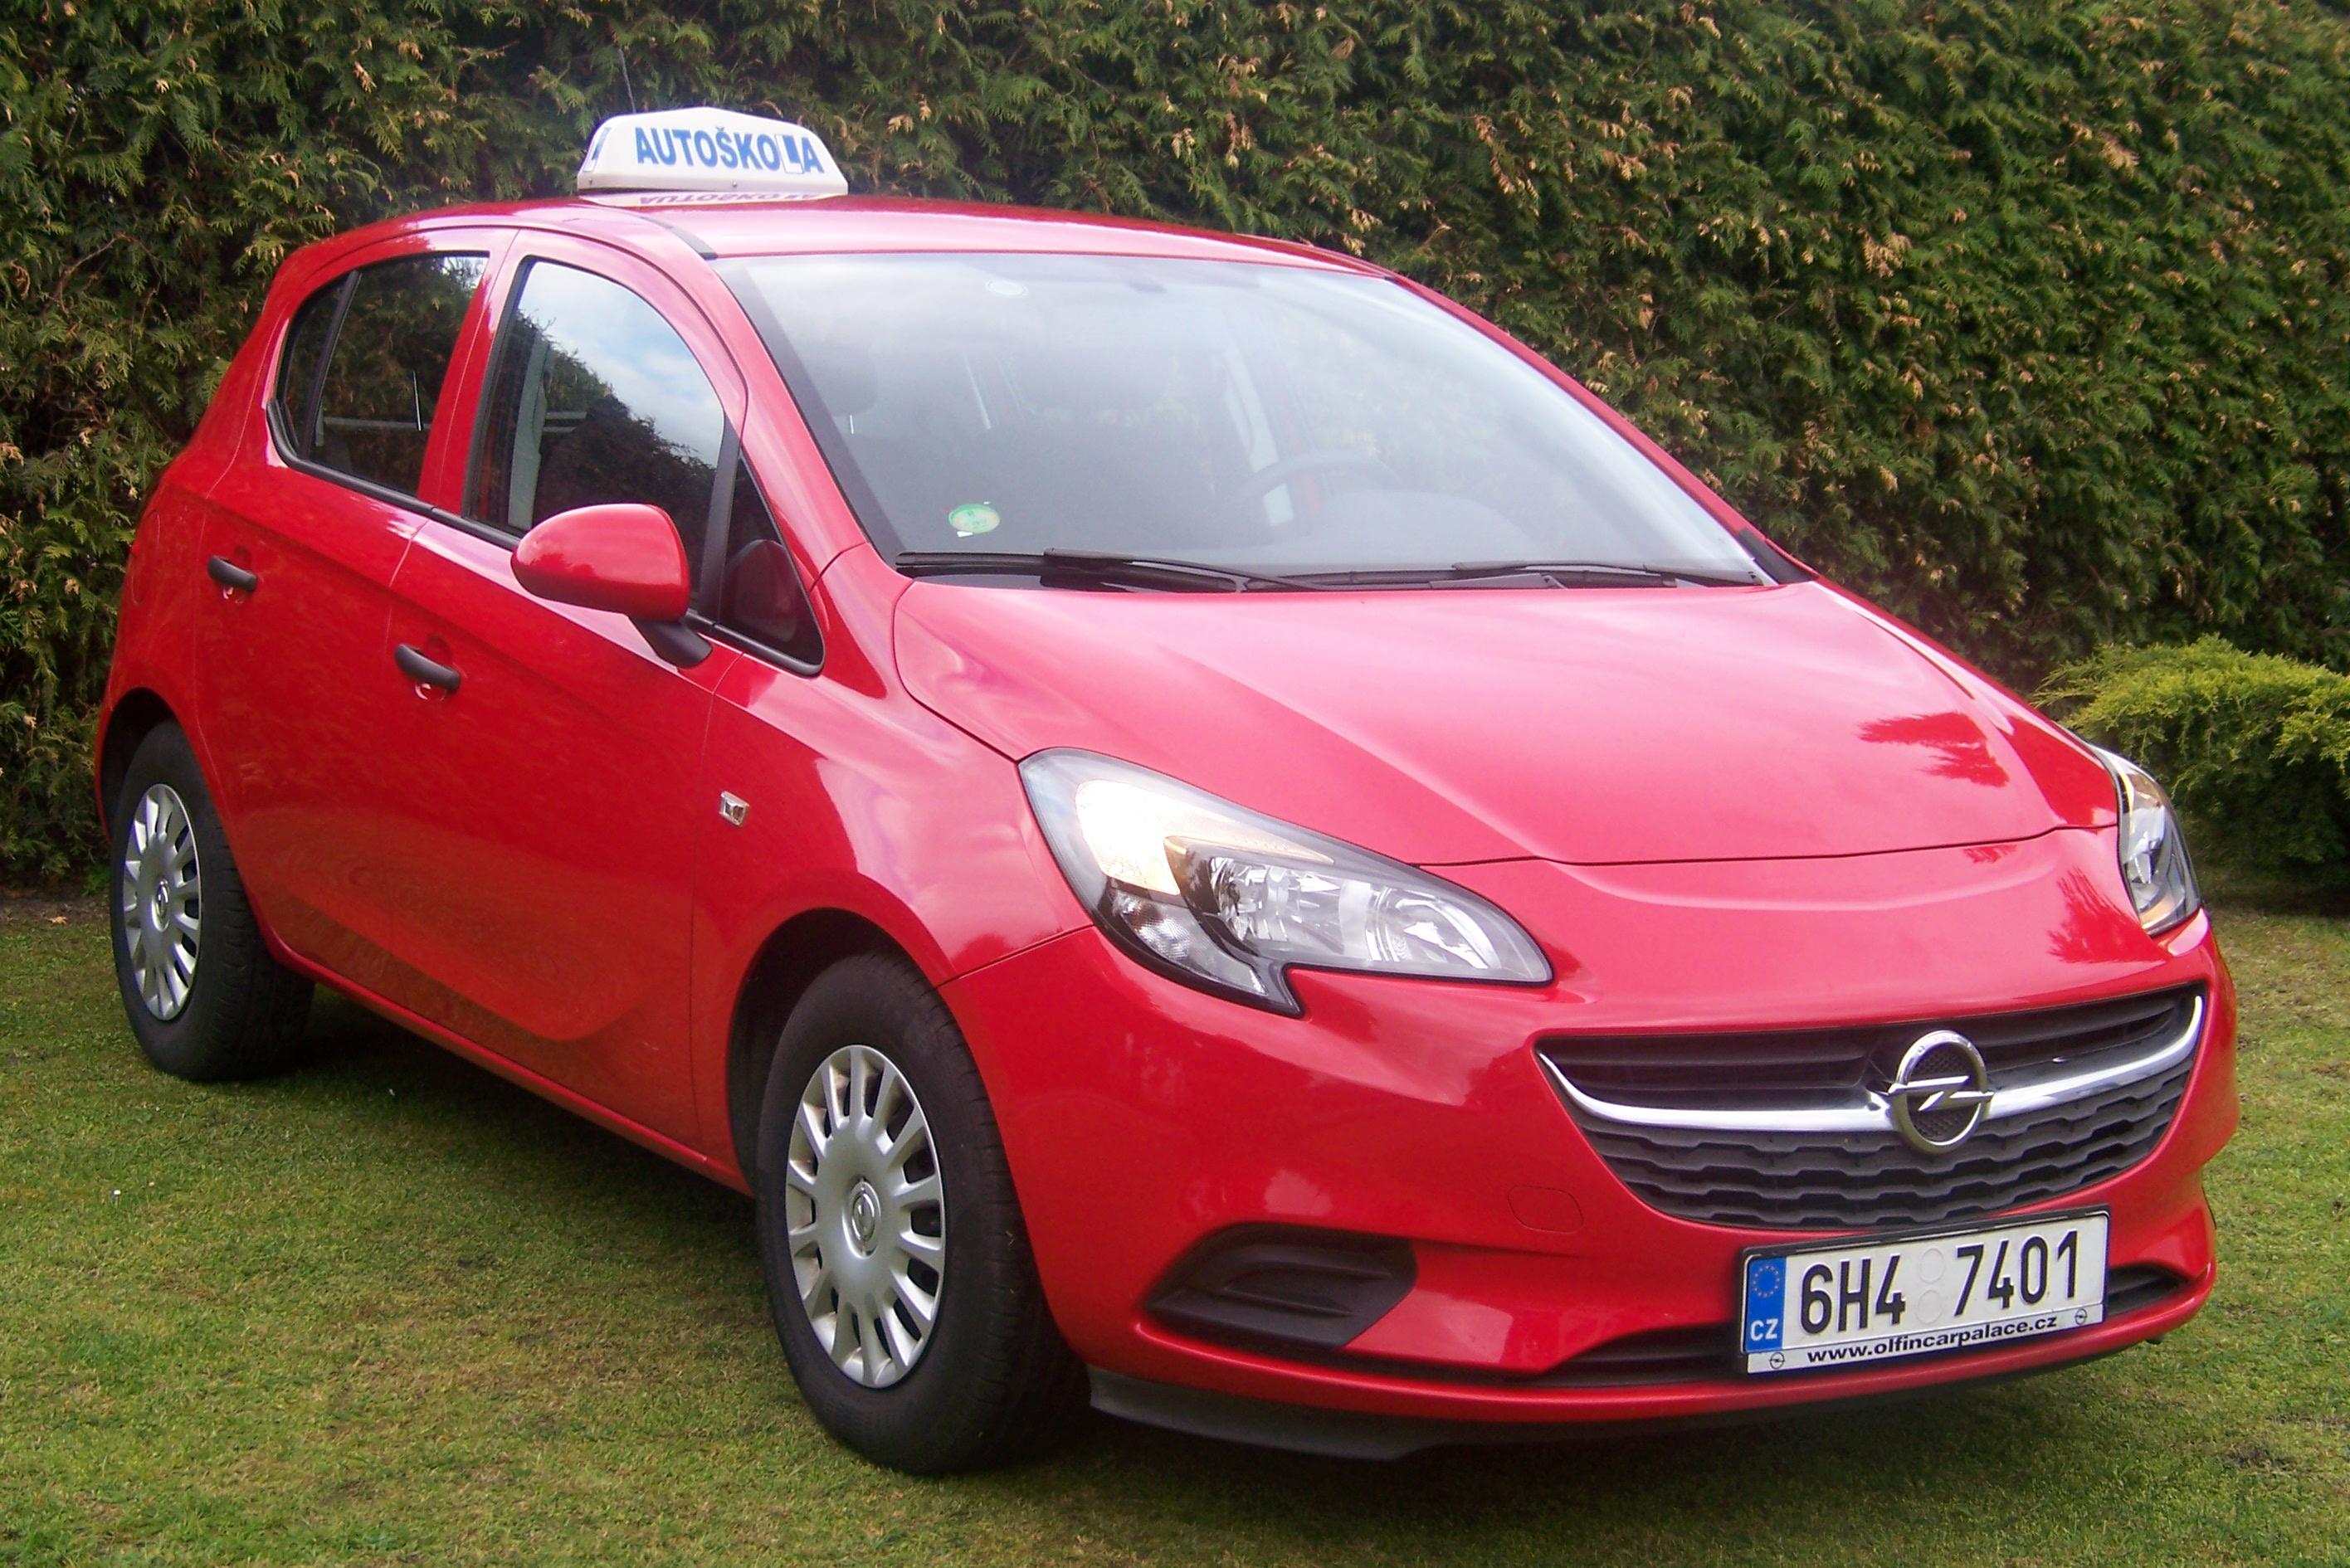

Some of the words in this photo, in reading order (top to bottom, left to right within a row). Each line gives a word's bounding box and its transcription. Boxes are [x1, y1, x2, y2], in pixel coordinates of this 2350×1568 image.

[635, 127, 824, 173] AUTOŠKOLA
[1801, 1254, 1906, 1333] 6H4
[1954, 1230, 2078, 1317] 7401
[1749, 1317, 1778, 1341] CZ
[1807, 1315, 2057, 1363] www.olfincarpalace.cz
